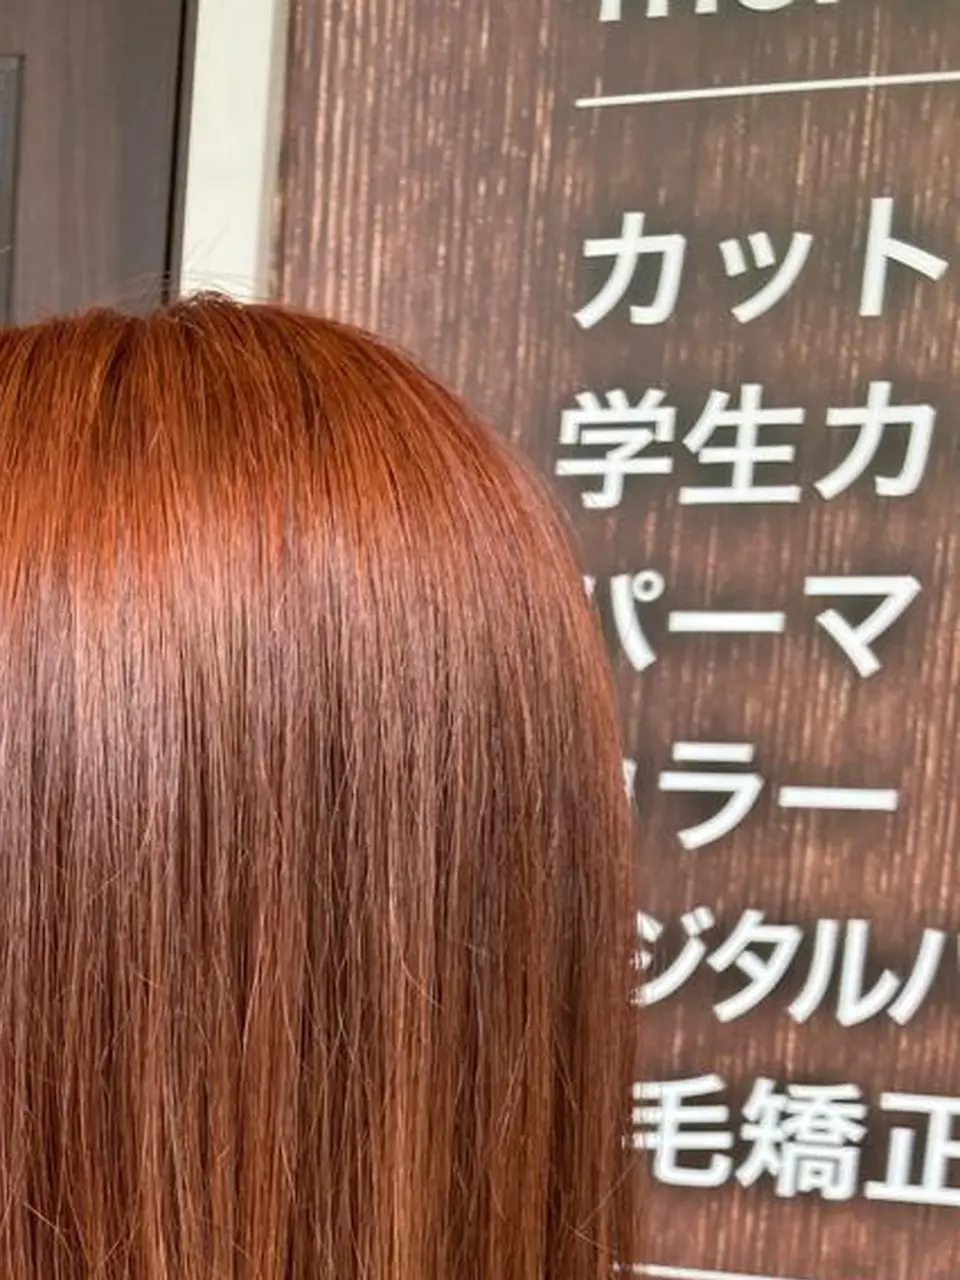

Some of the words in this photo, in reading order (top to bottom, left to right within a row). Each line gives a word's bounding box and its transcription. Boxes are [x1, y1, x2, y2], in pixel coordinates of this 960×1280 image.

[573, 196, 949, 330] カット
[555, 380, 937, 510] 学生カ
[583, 569, 922, 679] パーマ
[623, 741, 899, 851] ラー
[623, 1073, 960, 1207] 毛矯正
